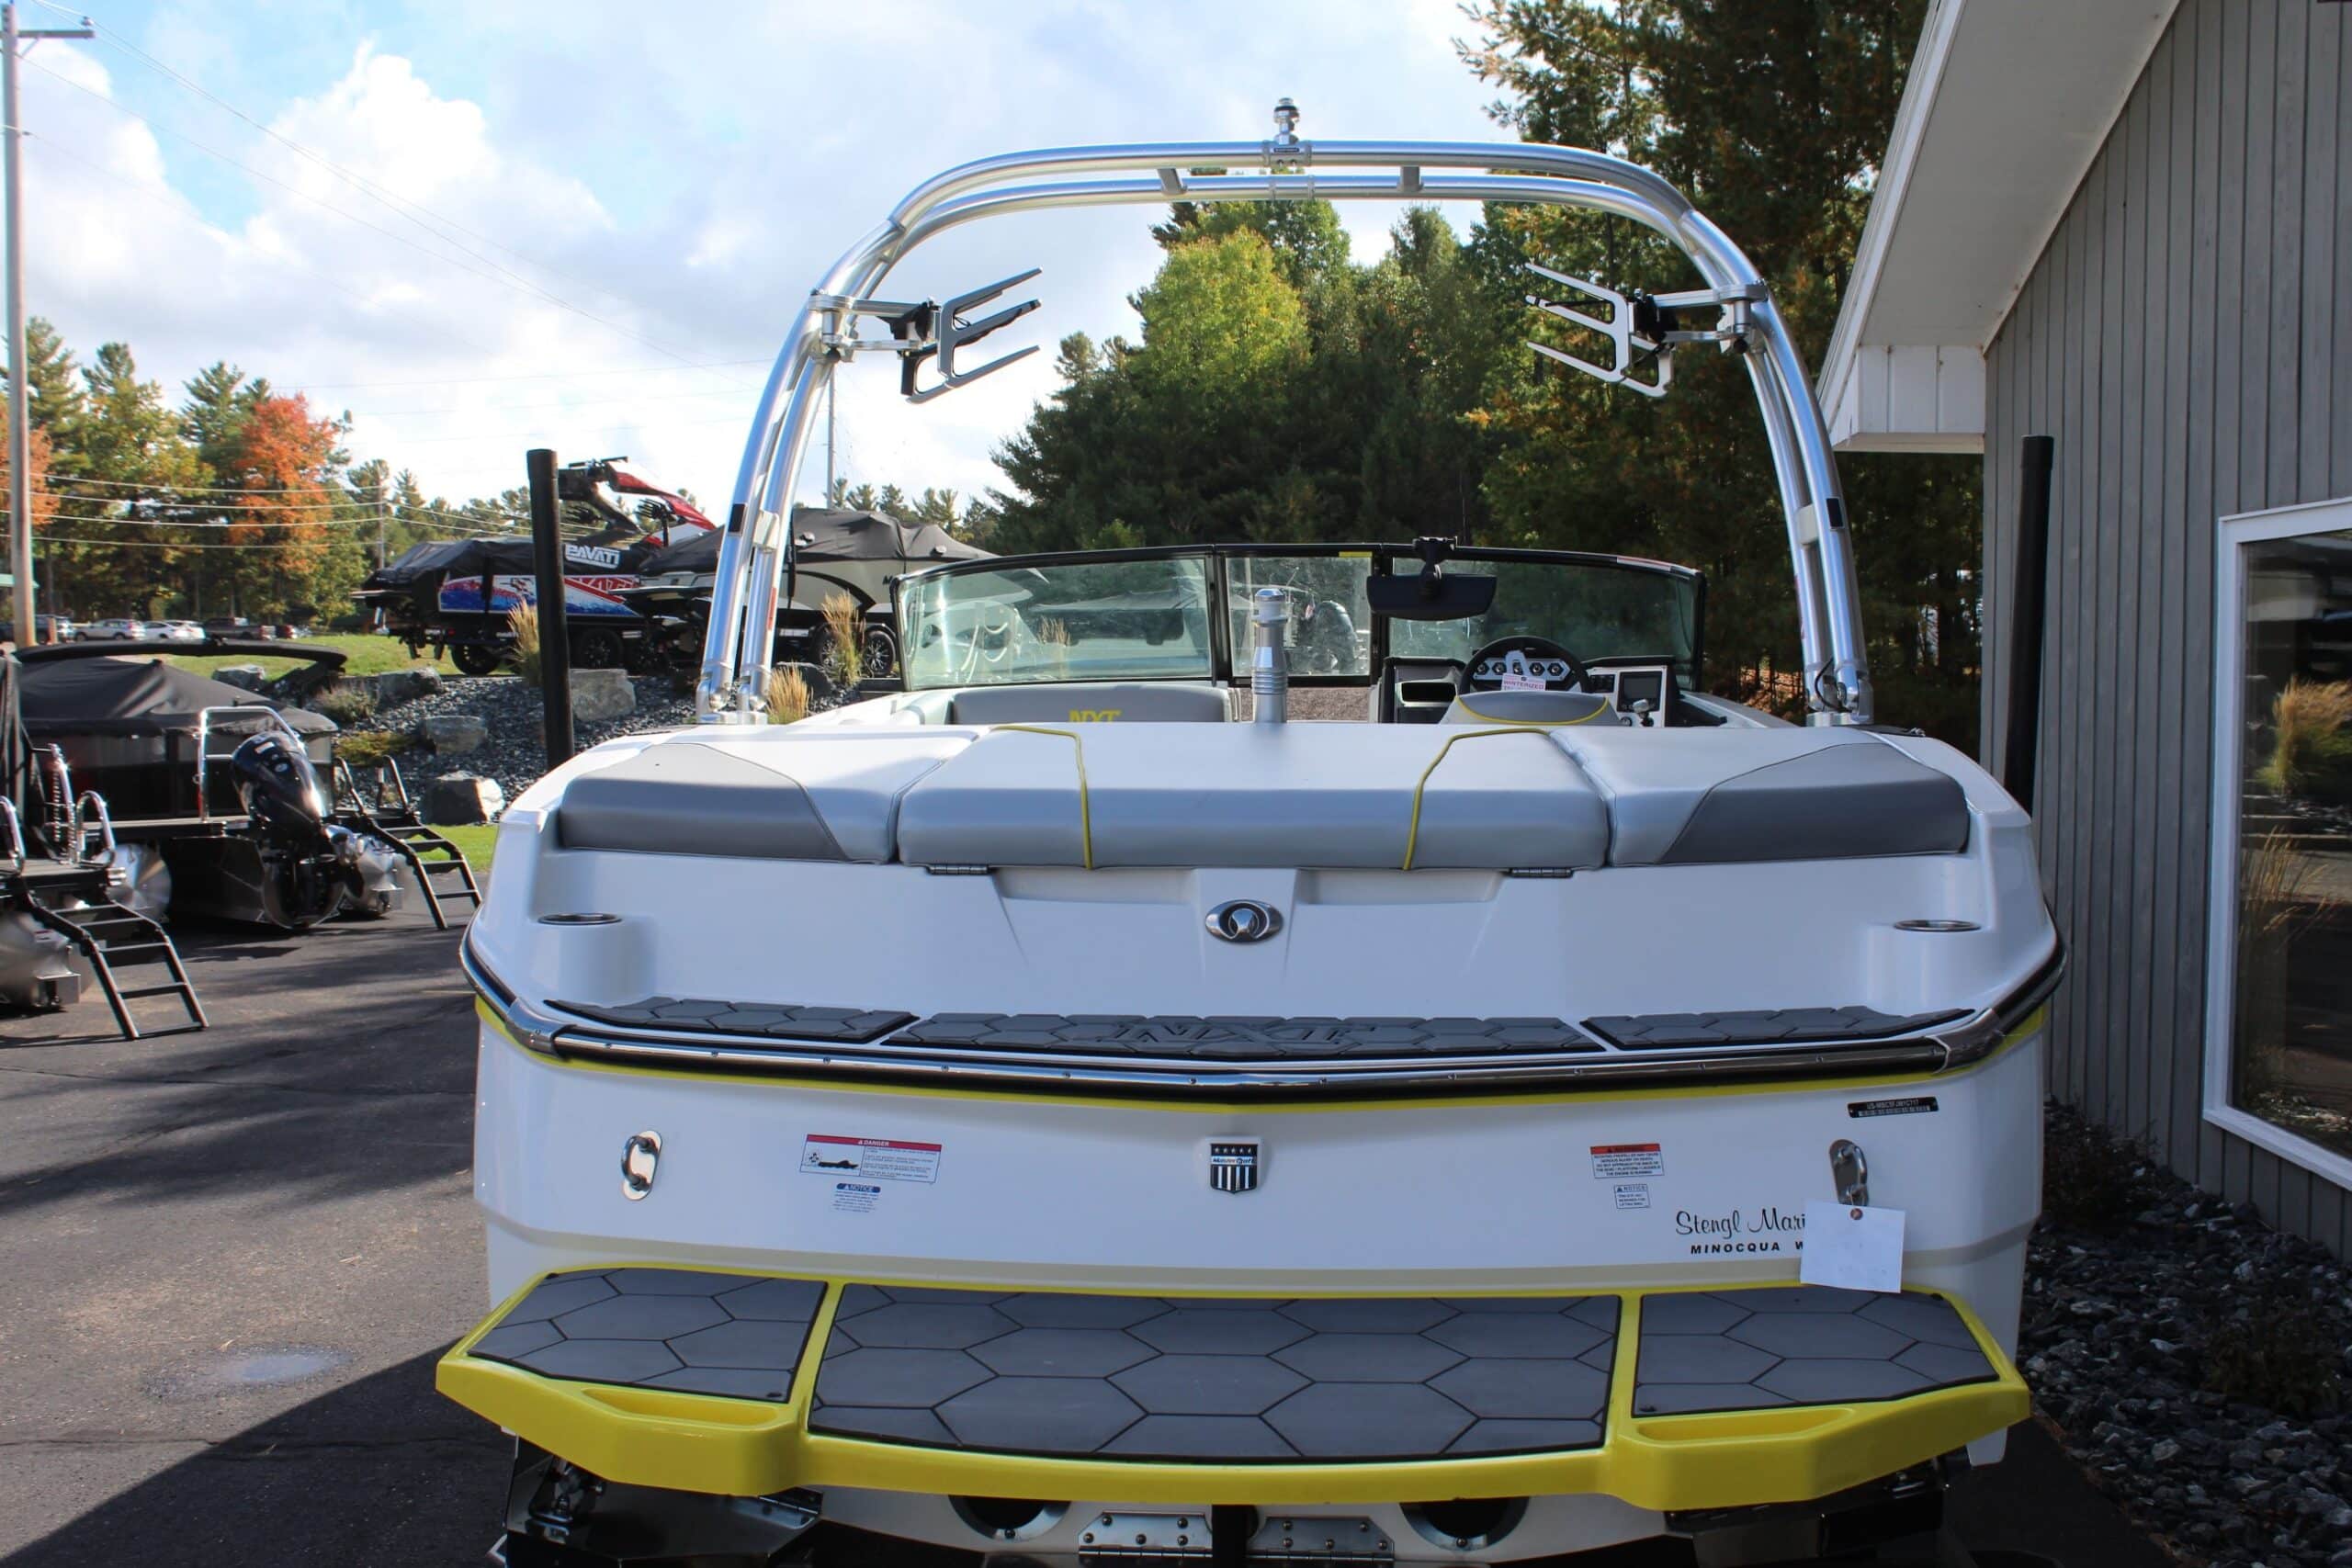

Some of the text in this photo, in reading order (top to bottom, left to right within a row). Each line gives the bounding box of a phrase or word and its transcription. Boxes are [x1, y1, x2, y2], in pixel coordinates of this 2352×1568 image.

[565, 544, 621, 569] PAVATI
[1069, 709, 1122, 722] NXT
[850, 1184, 874, 1192] NOTICE
[1676, 1207, 1805, 1240] Stengl Mari
[1690, 1241, 1804, 1254] MINOCQUA W
